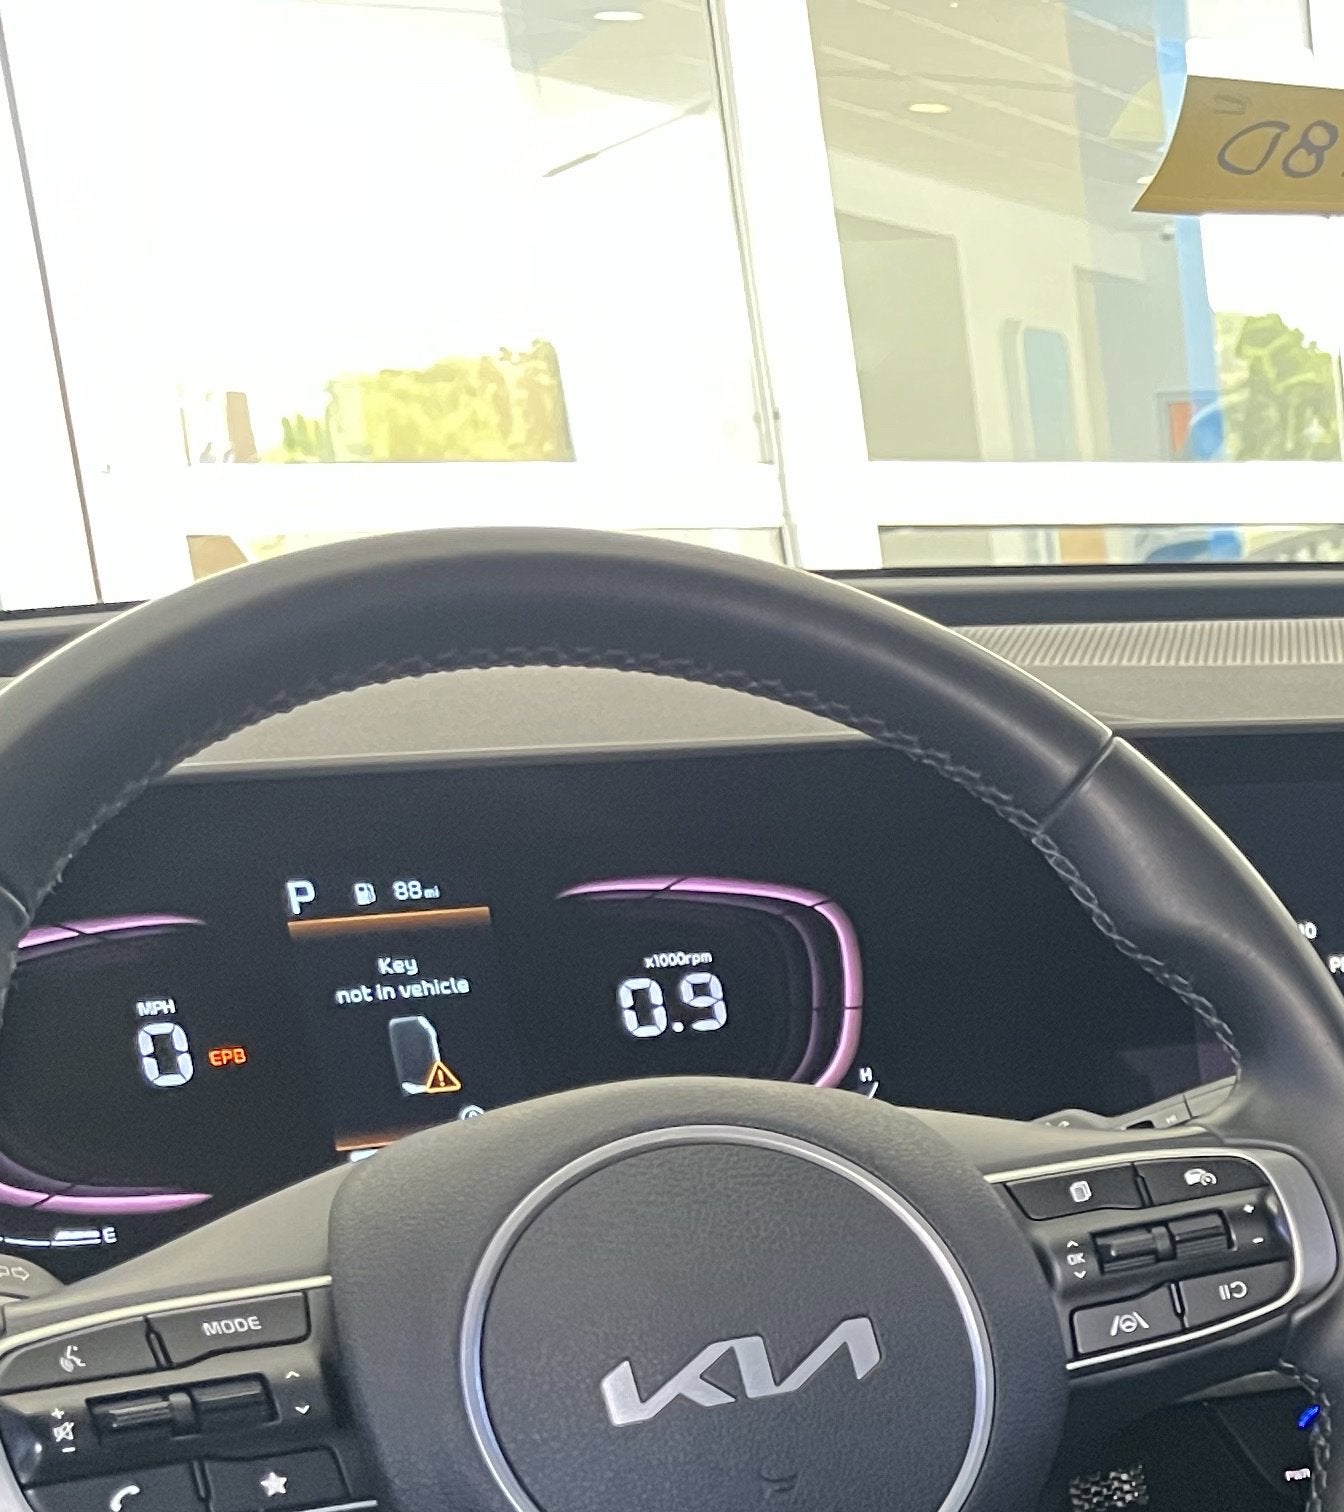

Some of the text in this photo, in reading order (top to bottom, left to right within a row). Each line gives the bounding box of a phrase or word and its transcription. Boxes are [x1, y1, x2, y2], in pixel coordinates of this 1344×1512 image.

[286, 879, 316, 915] P
[378, 956, 419, 976] Key
[644, 950, 713, 969] x1000rpm
[335, 977, 470, 1005] not in vehicle
[136, 999, 177, 1017] MPH
[618, 971, 728, 1039] 0.9
[138, 1022, 194, 1087] 0
[208, 1047, 248, 1067] EPB
[859, 1067, 872, 1082] H
[102, 1226, 118, 1244] E
[1066, 1251, 1086, 1266] OK
[202, 1314, 262, 1337] MODE
[601, 1316, 881, 1426] KIA
